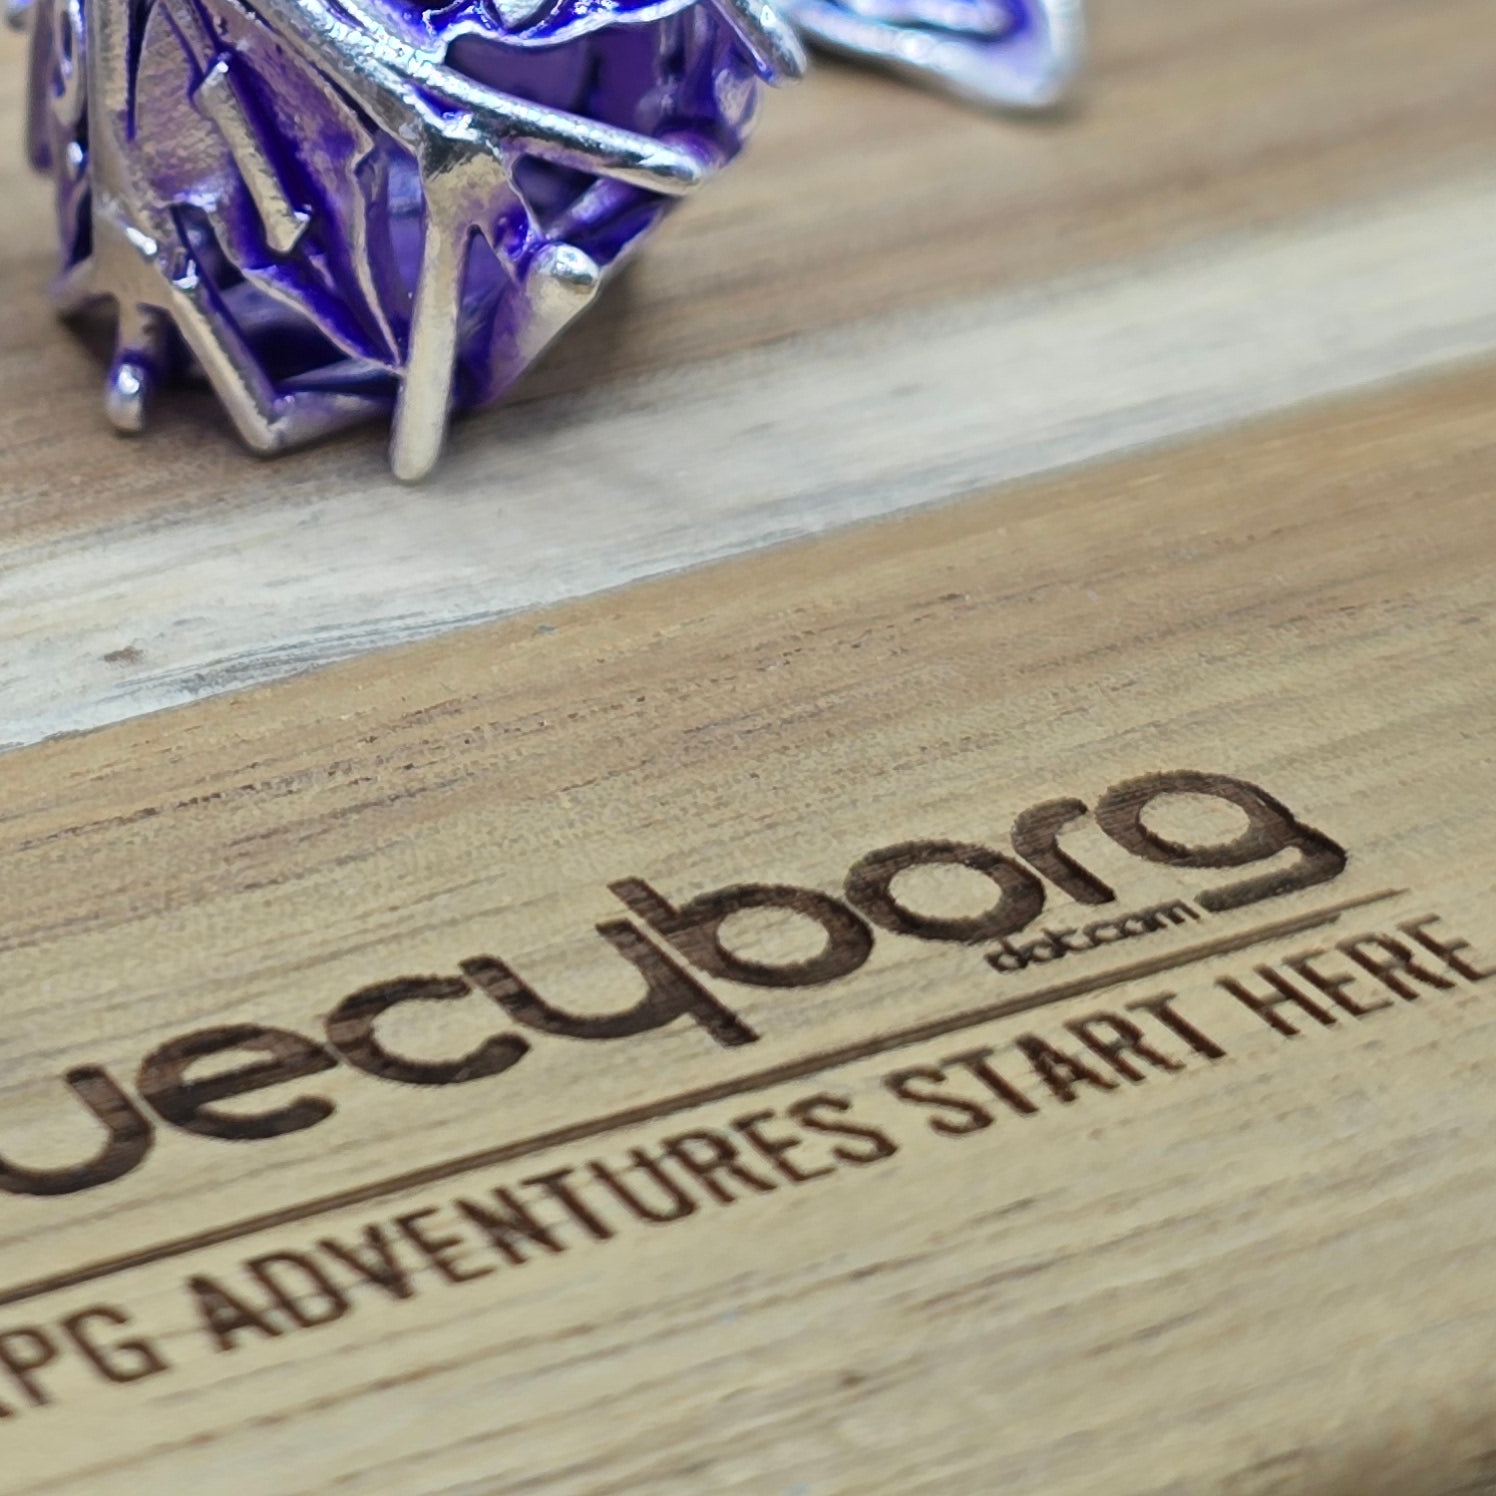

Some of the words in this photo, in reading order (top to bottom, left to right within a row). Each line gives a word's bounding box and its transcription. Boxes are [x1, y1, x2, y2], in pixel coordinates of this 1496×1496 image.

[185, 1095, 899, 1351] ADVENTURES
[882, 992, 1227, 1140] START
[1214, 913, 1496, 1037] HERE
